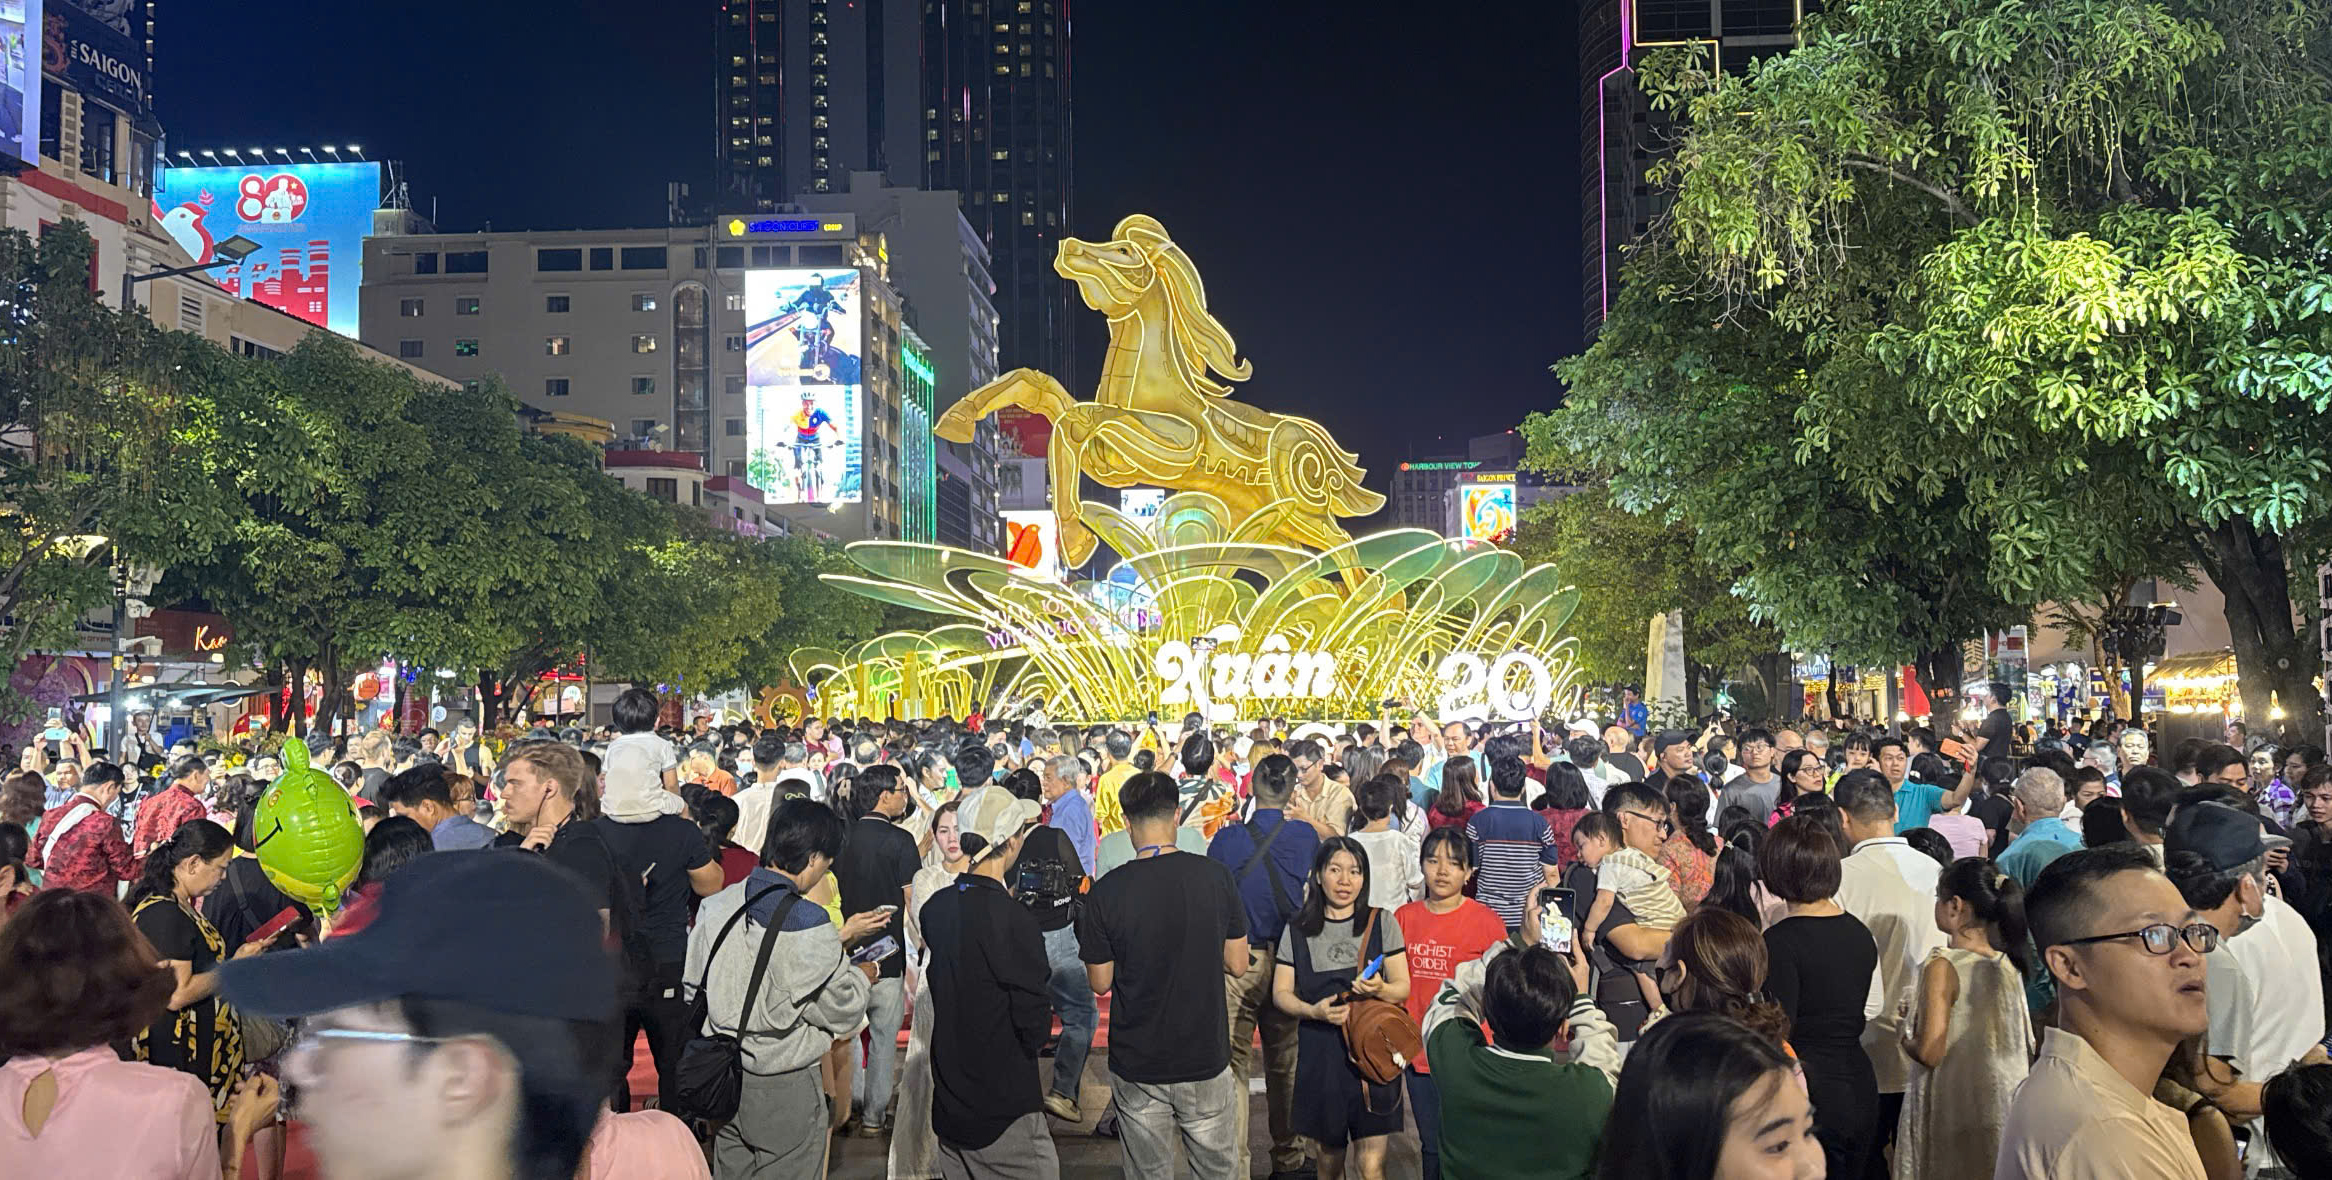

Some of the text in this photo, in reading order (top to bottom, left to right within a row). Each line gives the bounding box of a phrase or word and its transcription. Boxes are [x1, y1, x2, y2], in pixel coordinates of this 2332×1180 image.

[80, 43, 141, 89] SAIGON
[1409, 462, 1443, 470] HARBOUR
[1463, 462, 1482, 470] TOW
[1477, 474, 1497, 482] SAIGON
[1156, 624, 1336, 721] Xuân
[1408, 943, 1456, 957] HIGHEST
[1412, 957, 1448, 972] ORDER
